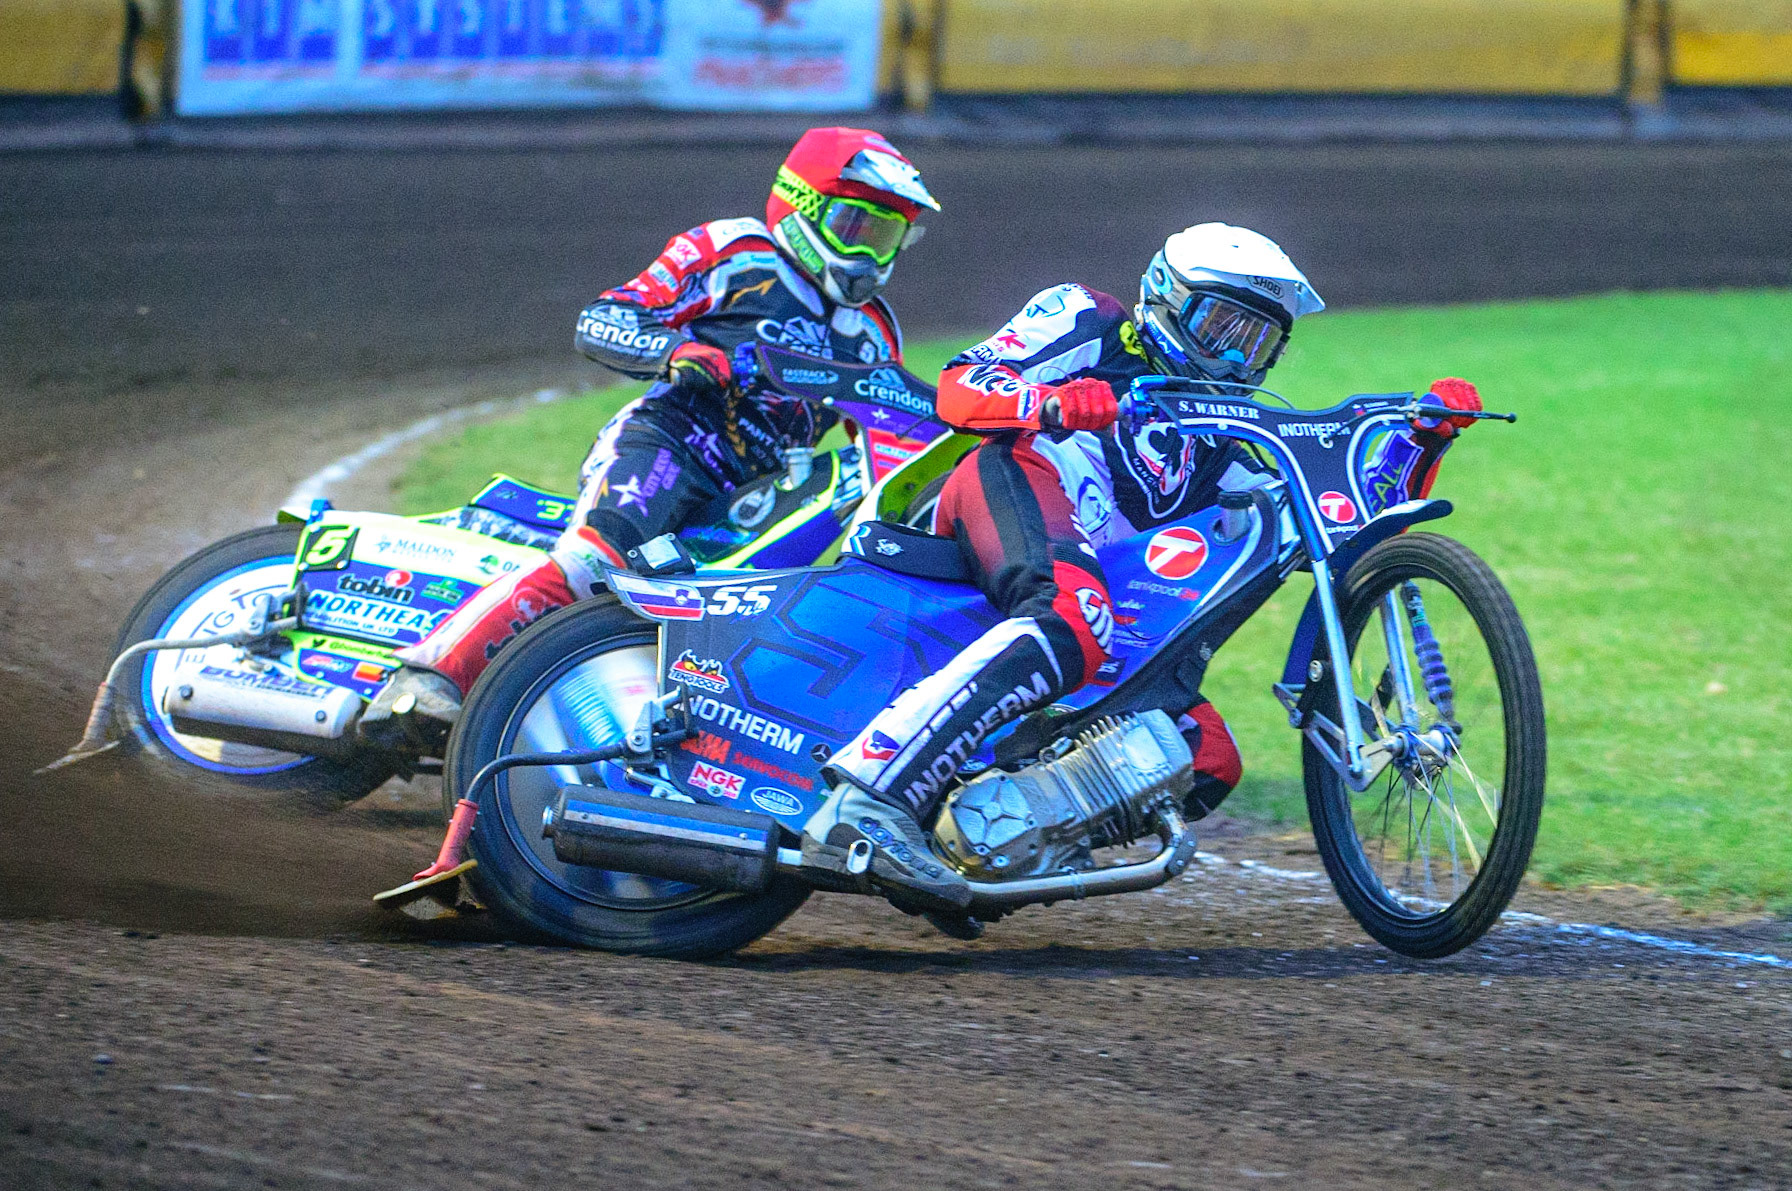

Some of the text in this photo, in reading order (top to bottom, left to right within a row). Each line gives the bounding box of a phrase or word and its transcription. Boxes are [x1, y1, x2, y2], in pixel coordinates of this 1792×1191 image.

[854, 379, 934, 416] Crendon
[1194, 401, 1260, 420] WARNER
[396, 539, 455, 557] MALDON
[339, 575, 413, 602] tobin
[674, 694, 805, 755] NOTHERM
[903, 671, 1051, 809] INOTHERM
[693, 764, 742, 792] NGK
[762, 789, 794, 807] JAWA
